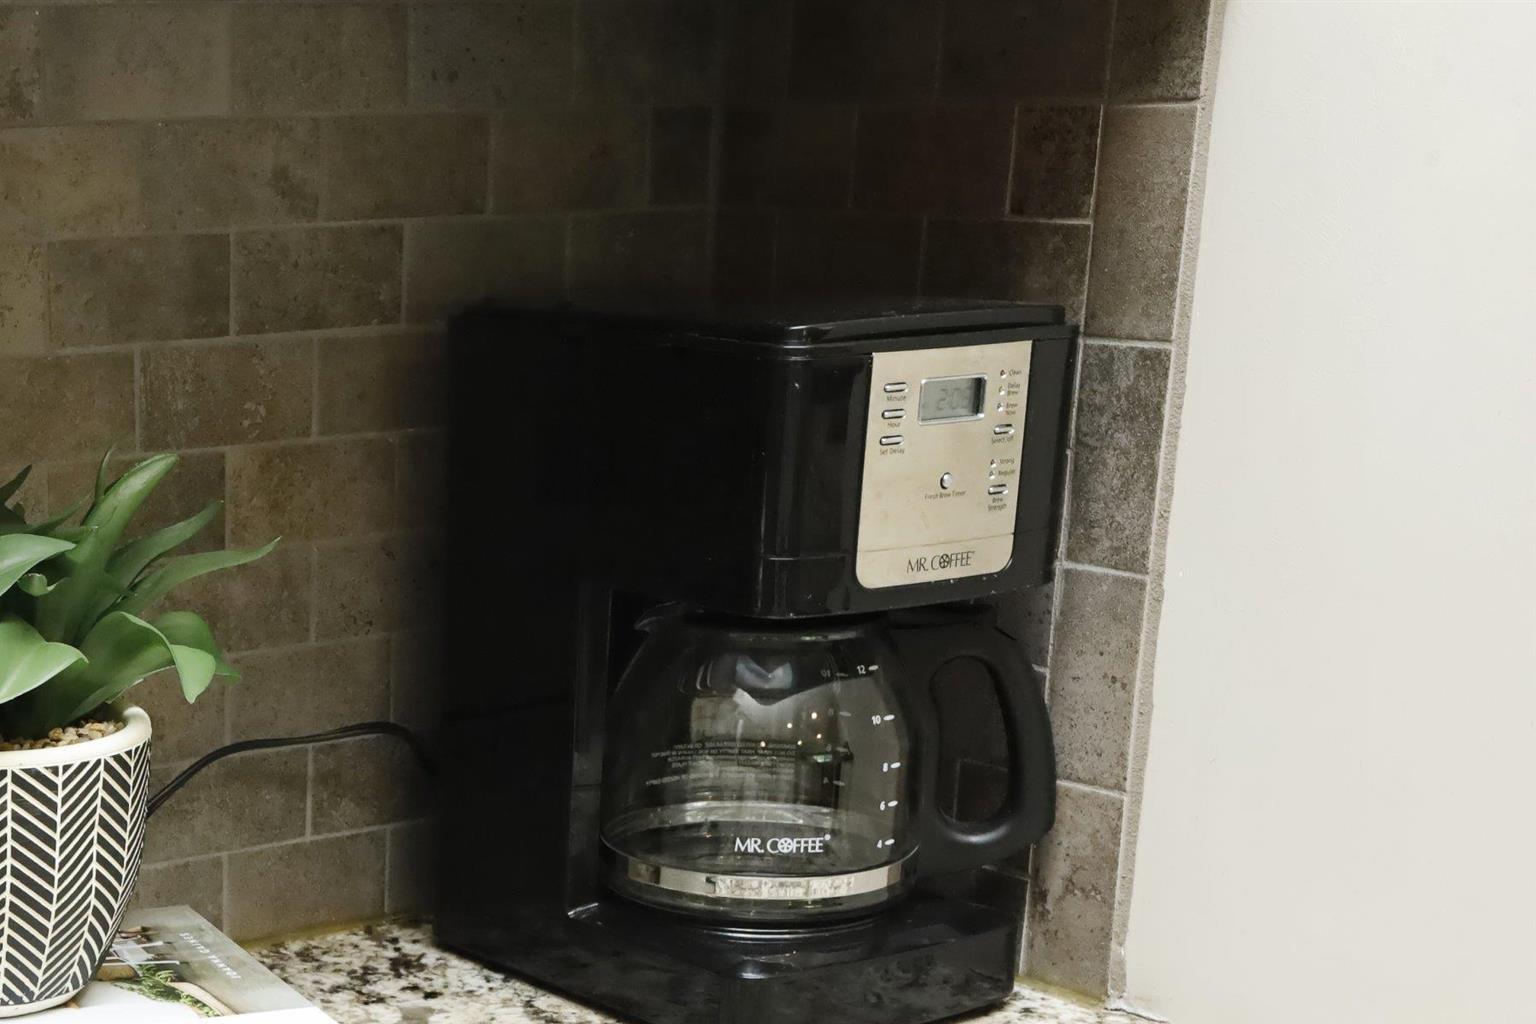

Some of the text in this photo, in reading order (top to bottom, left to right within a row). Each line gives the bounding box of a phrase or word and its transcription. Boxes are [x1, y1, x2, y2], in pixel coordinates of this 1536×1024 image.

[907, 550, 971, 573] MR. COFFEE
[856, 664, 866, 675] 12
[871, 714, 882, 726] 10
[882, 762, 889, 773] 8
[879, 800, 886, 811] 6
[734, 837, 824, 853] MR. COFFEE
[877, 839, 883, 849] 4
